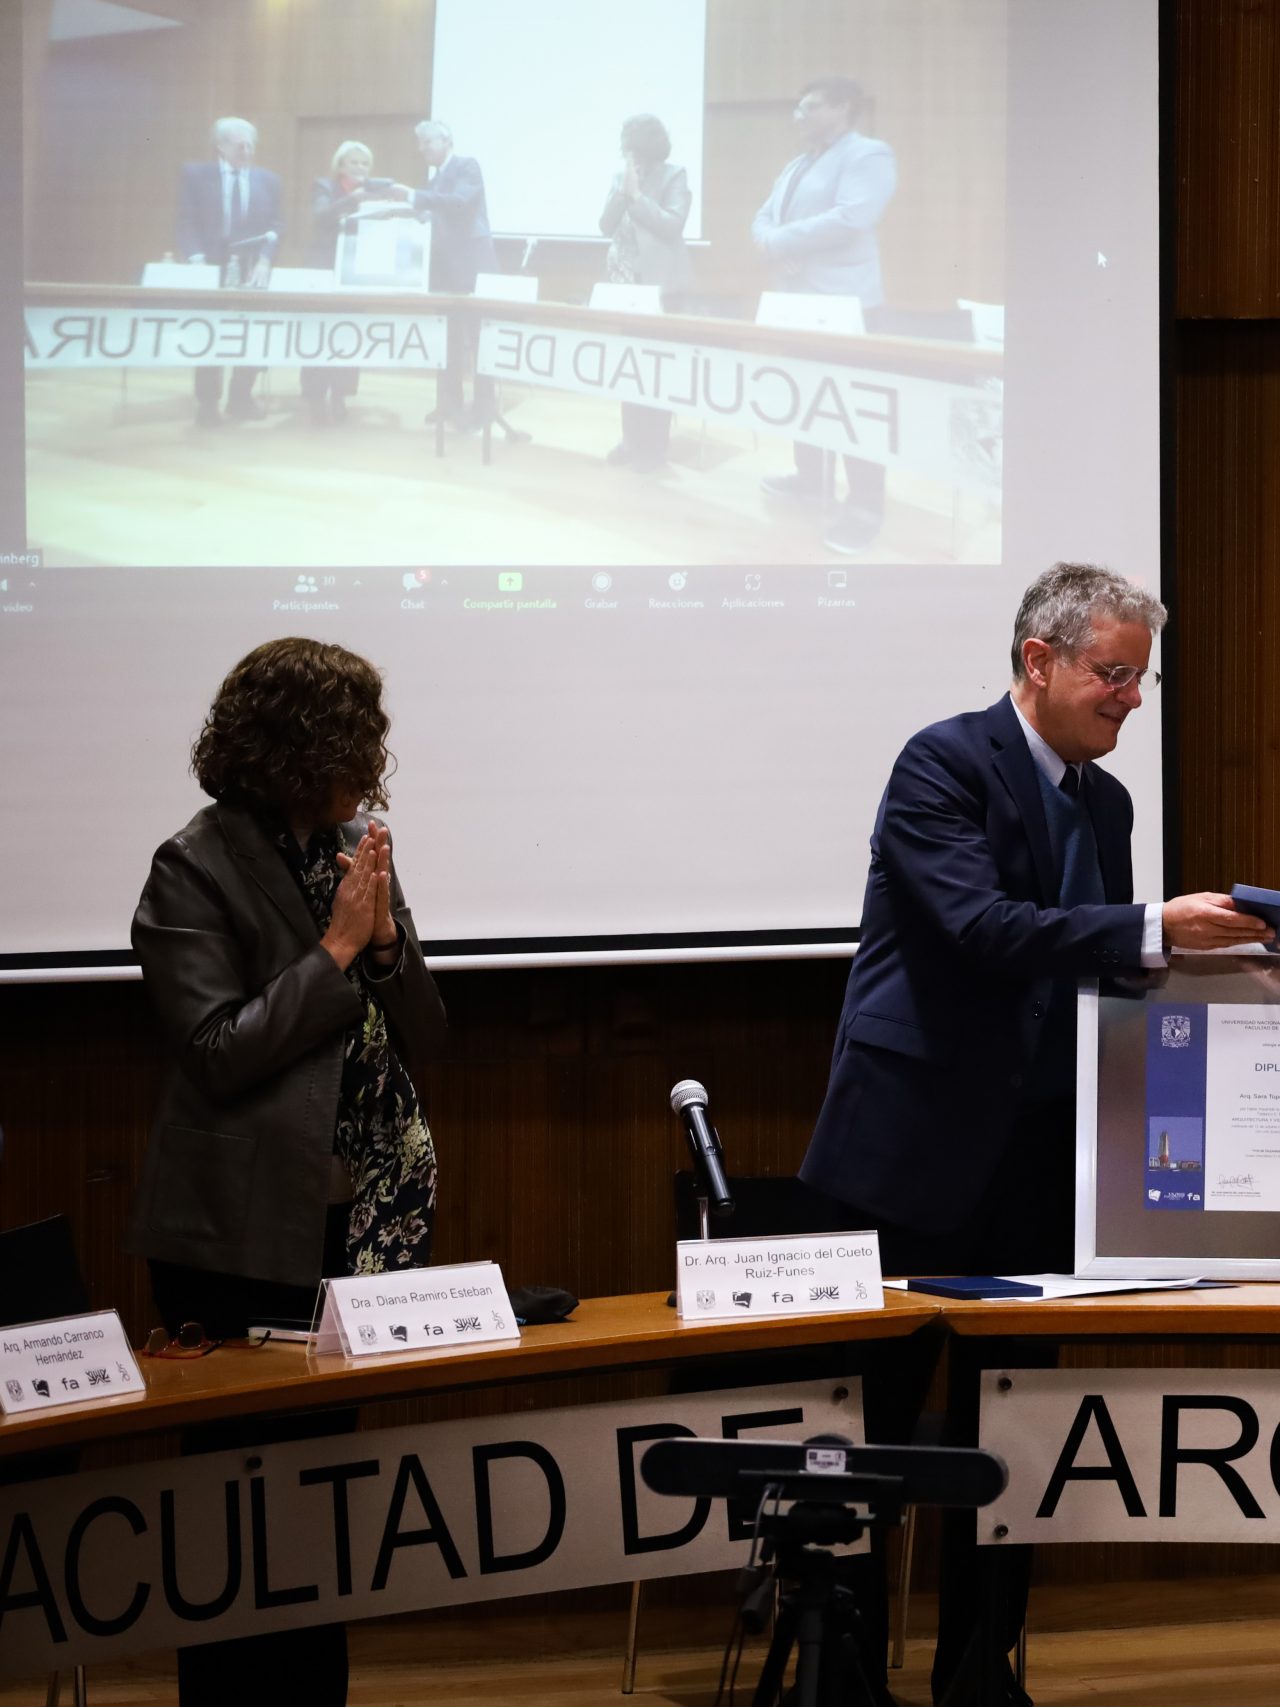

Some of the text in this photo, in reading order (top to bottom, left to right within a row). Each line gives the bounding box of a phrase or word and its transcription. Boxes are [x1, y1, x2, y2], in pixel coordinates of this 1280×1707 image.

[273, 600, 339, 611] Participantes
[400, 600, 425, 610] Chat
[463, 598, 558, 611] Compartir pantalla
[584, 598, 619, 610] Grabar
[648, 598, 705, 610] Reacciones
[721, 597, 785, 610] Aplicaciones
[1187, 1192, 1200, 1201] fa
[684, 1247, 873, 1268] Dr. Arq. Juan Ignacio del Cueto
[745, 1265, 815, 1279] Ruiz-Funes
[351, 1285, 493, 1309] Dra. Diana Ramiro Esteban
[771, 1291, 794, 1304] fa
[423, 1323, 443, 1337] fa
[3, 1327, 105, 1354] Arq. Armando Carranco
[35, 1348, 84, 1367] Hernández
[61, 1377, 80, 1392] fa
